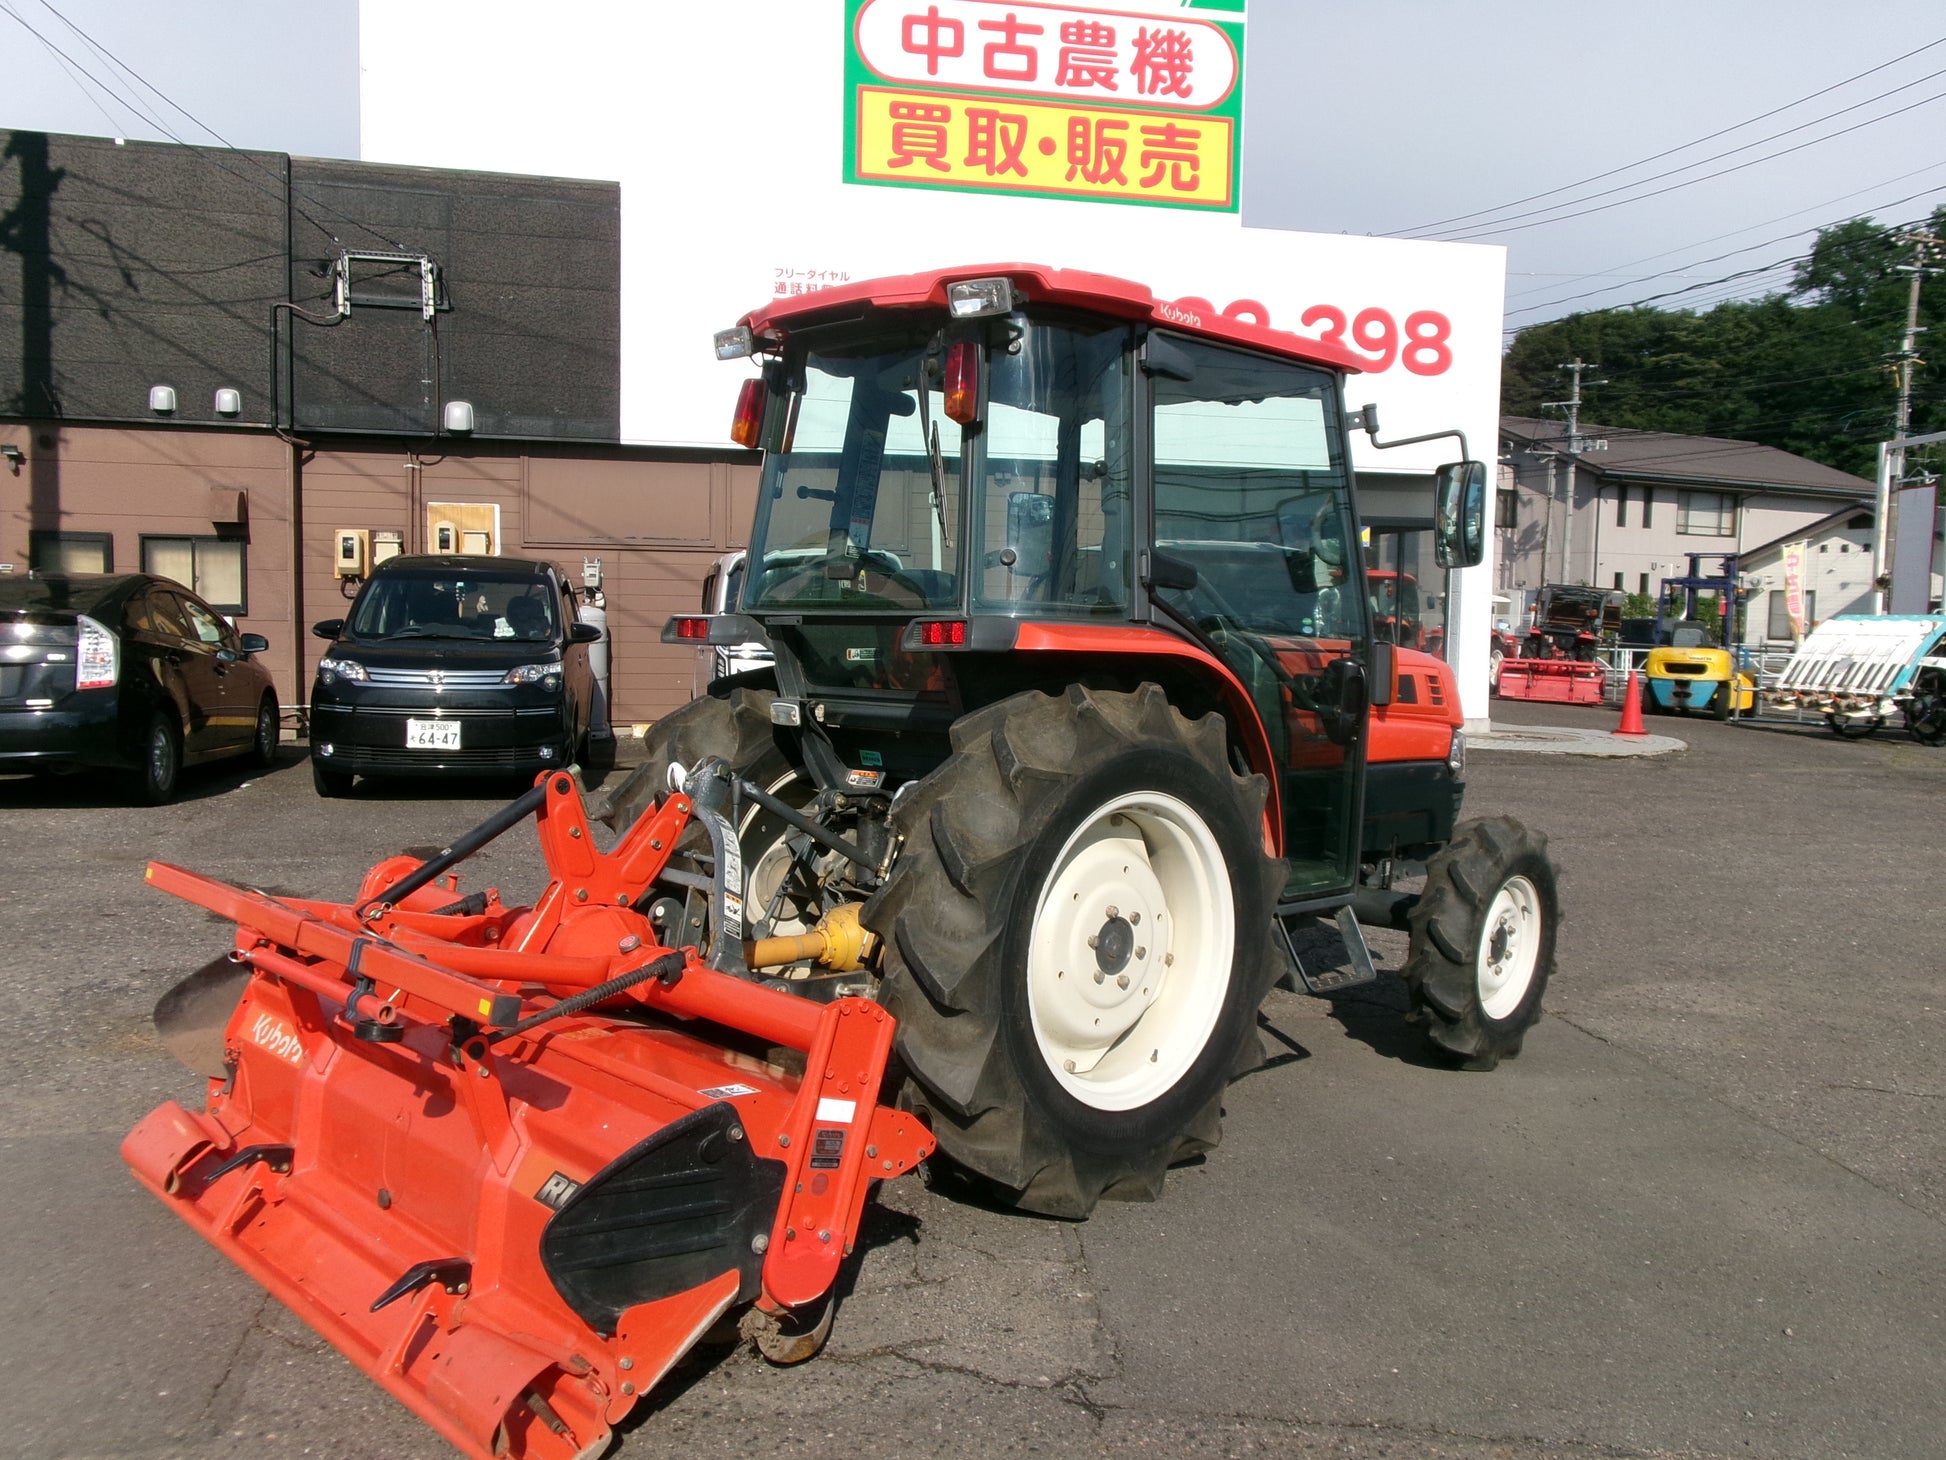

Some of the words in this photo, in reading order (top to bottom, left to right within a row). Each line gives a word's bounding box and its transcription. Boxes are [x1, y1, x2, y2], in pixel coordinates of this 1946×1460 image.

[901, 4, 1194, 98] 中古農機
[886, 100, 1202, 192] 買取・販売
[774, 267, 851, 281] フリーダイヤル
[1160, 303, 1201, 327] Kubota
[418, 732, 458, 745] 64-47
[436, 723, 450, 731] 500
[252, 1013, 303, 1064] Kubota
